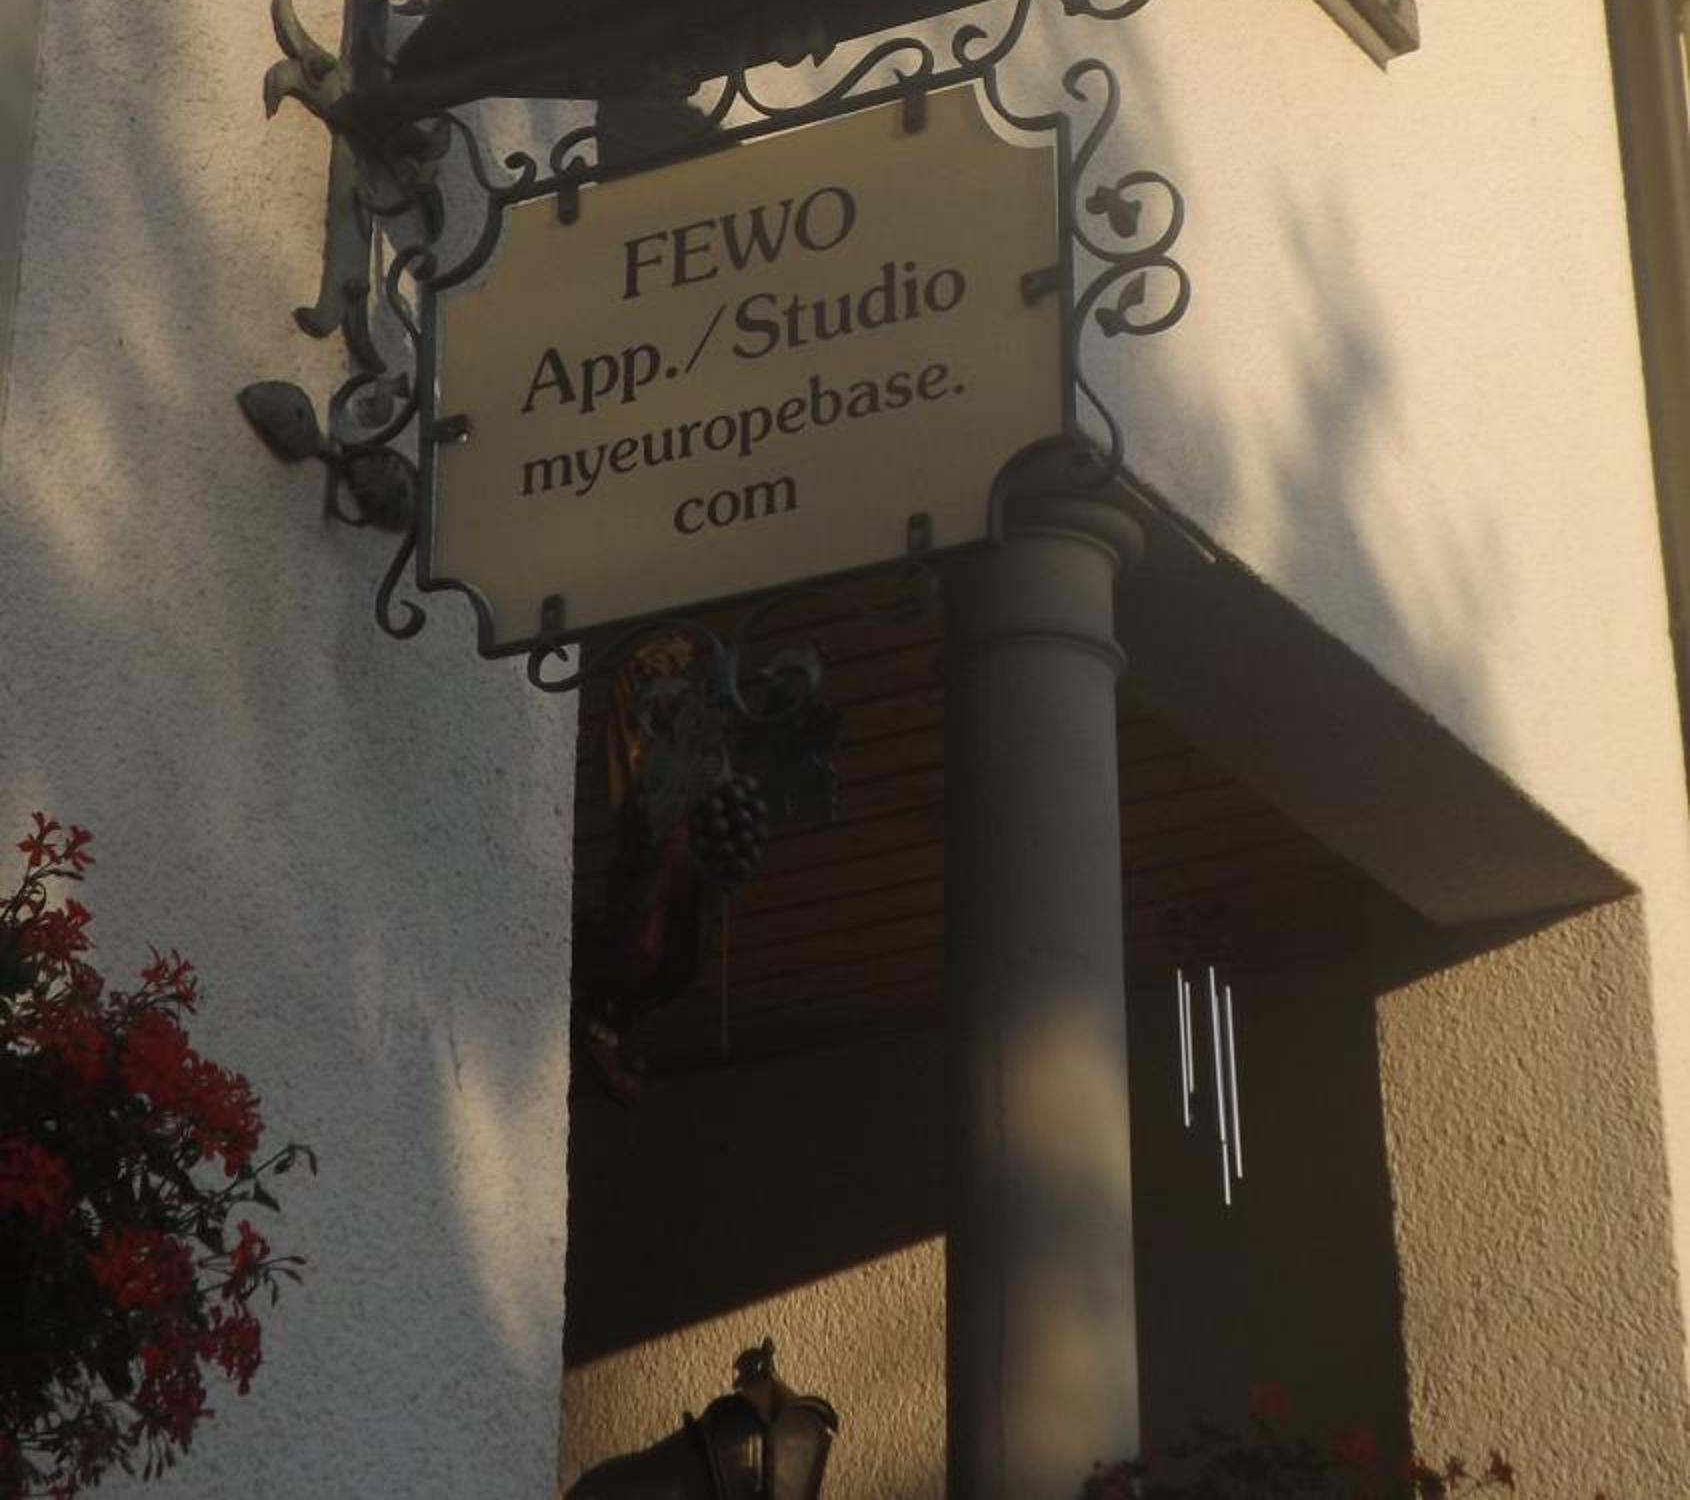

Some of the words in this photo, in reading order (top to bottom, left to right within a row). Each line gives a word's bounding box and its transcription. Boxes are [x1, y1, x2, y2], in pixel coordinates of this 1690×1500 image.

[622, 187, 856, 299] FEWO
[520, 261, 966, 414] App./Studio
[520, 363, 966, 497] myeuropebase.
[673, 475, 797, 534] com
